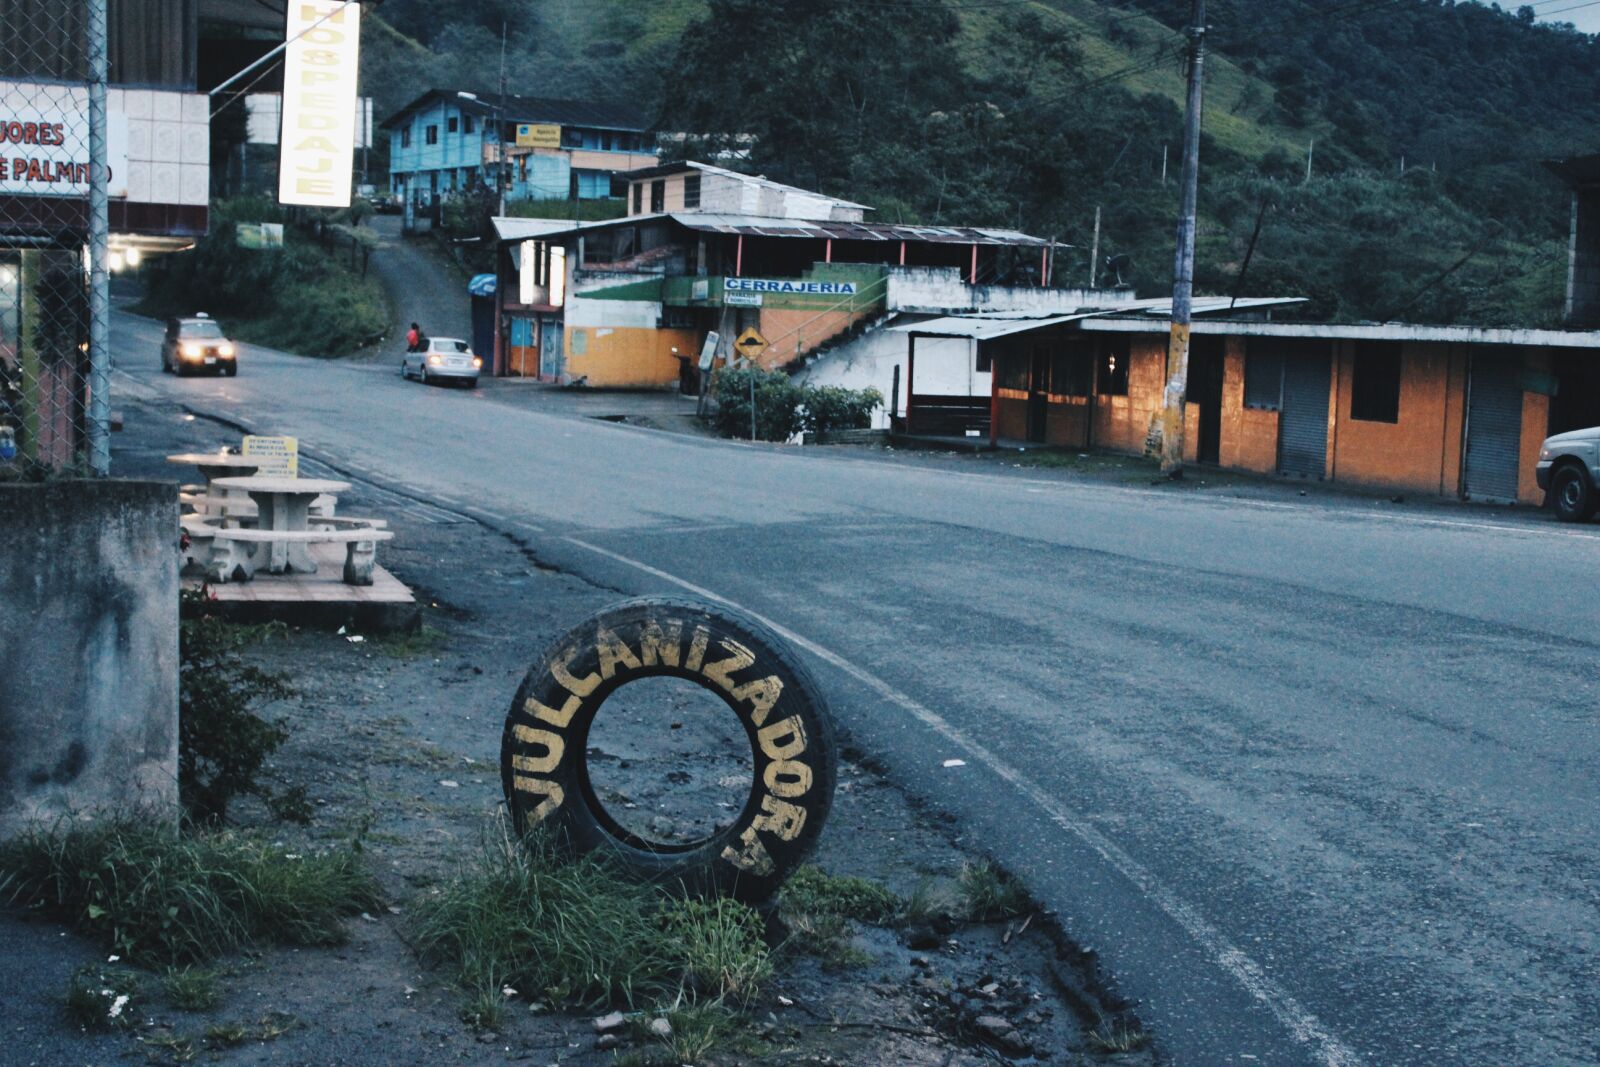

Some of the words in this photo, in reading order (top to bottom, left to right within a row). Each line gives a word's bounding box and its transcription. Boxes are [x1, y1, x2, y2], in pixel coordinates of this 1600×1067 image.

[294, 5, 345, 196] HOSPEDAJE
[726, 278, 854, 294] CERRAJERIA
[512, 618, 813, 877] VULCANIZADORA
